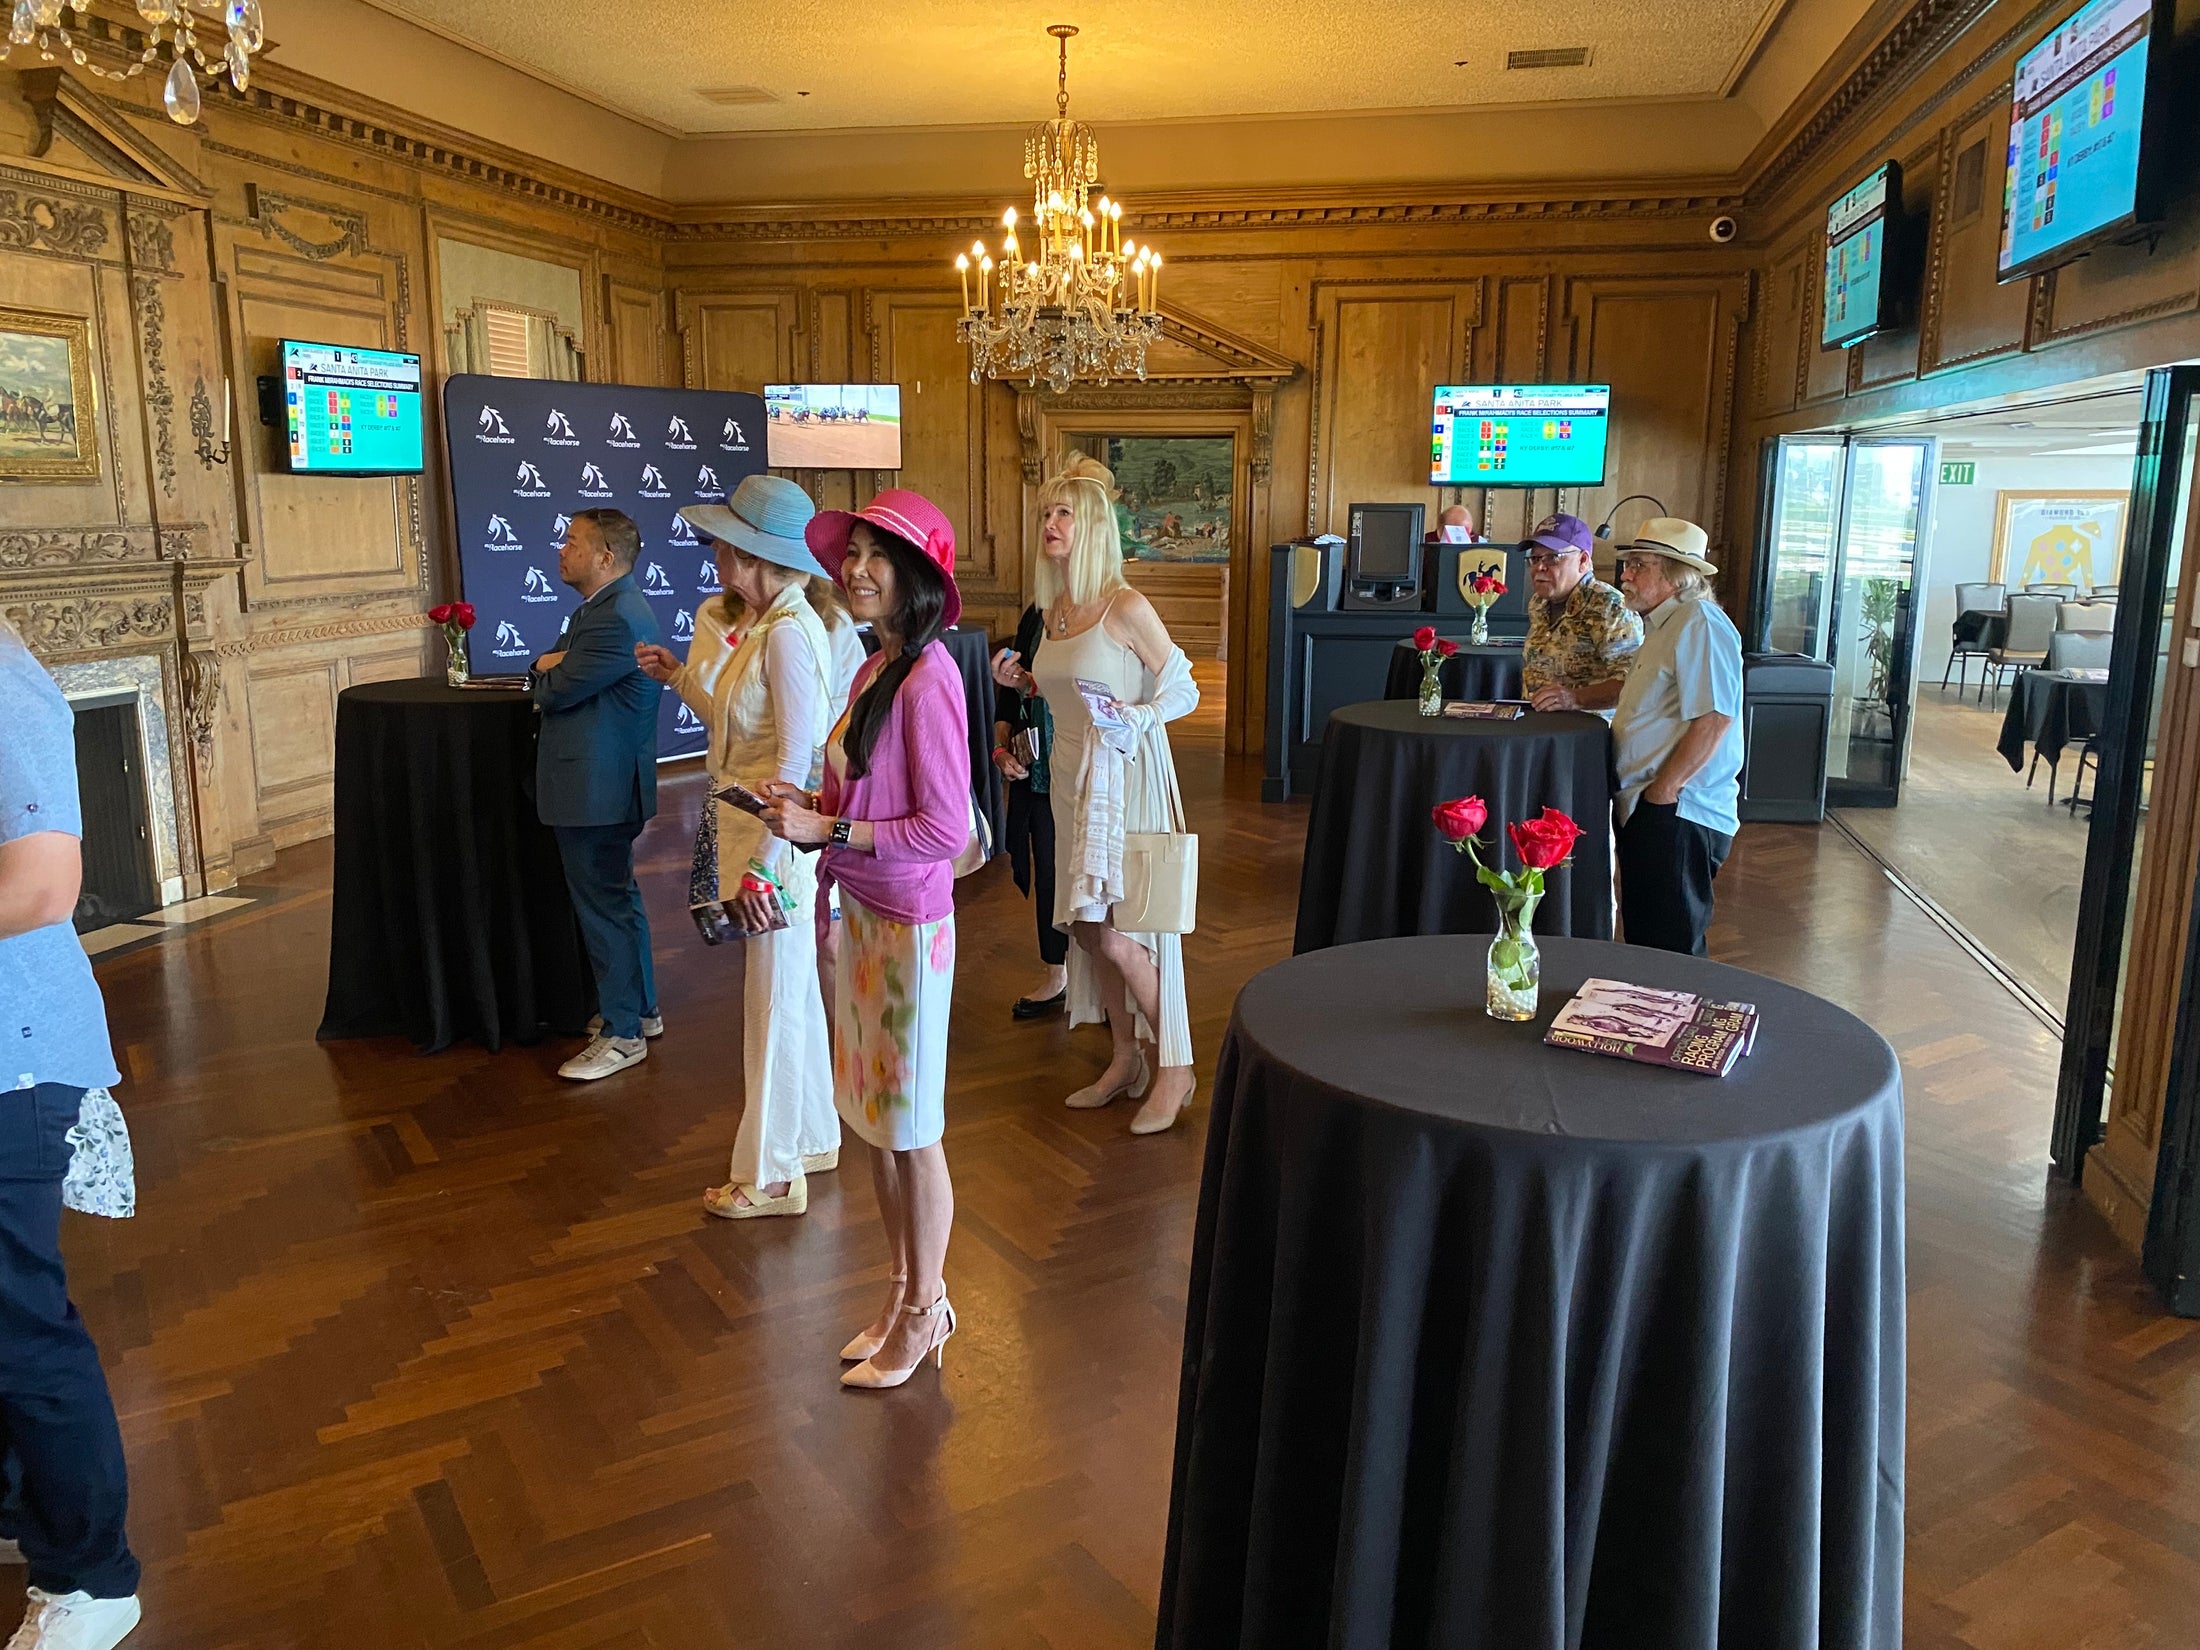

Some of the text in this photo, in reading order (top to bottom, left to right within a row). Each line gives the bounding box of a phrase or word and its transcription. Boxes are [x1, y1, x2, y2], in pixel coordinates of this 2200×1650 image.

[321, 363, 388, 378] SANTA ANITA PARK
[1475, 400, 1506, 408] SANTA
[1940, 464, 1971, 483] EXIT
[1551, 1035, 1621, 1053] HOLLYWOOD
[1681, 1034, 1709, 1066] RACING
[1696, 1029, 1729, 1069] PROGRAM
